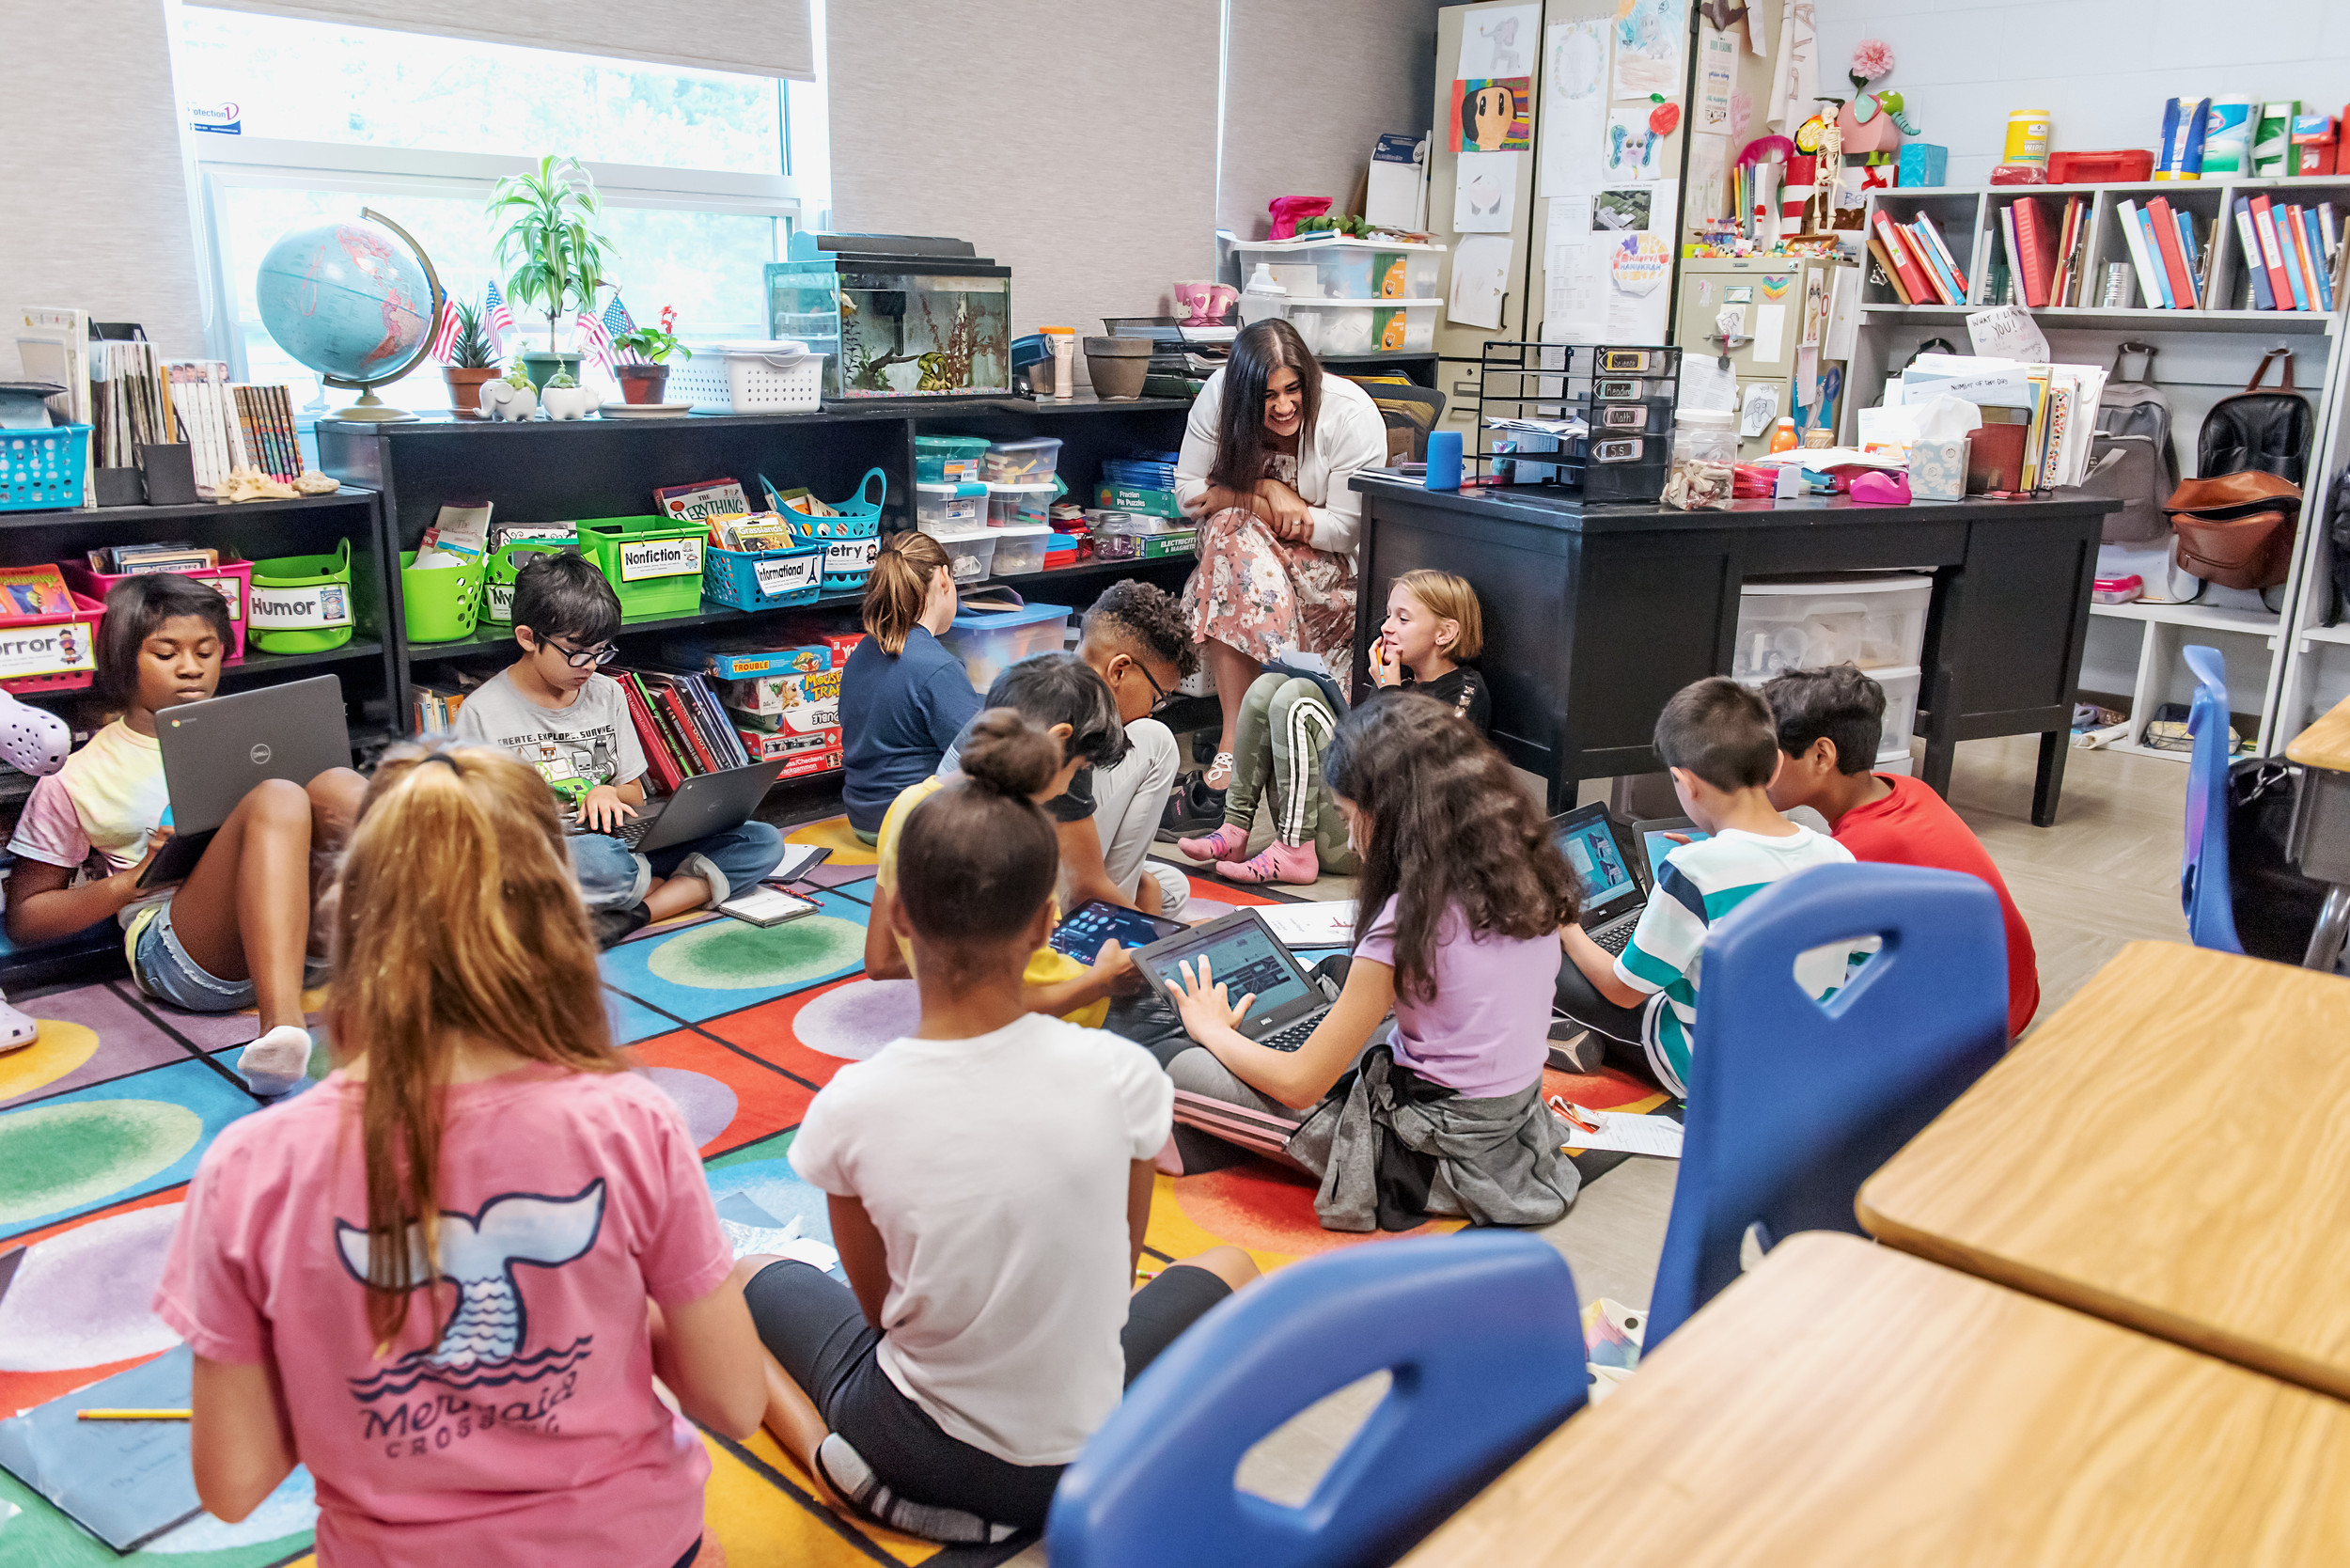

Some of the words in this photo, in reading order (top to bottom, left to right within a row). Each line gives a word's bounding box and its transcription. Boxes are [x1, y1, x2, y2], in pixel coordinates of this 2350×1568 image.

[188, 107, 227, 118] otection
[1613, 354, 1636, 368] Science
[1610, 411, 1631, 424] Math
[739, 525, 783, 534] Grasslands
[625, 548, 682, 566] Nonfiction
[826, 544, 863, 558] etry
[757, 562, 804, 582] Informational
[251, 597, 316, 616] Humor
[0, 637, 57, 656] rror
[733, 660, 770, 673] TROUBLE
[804, 669, 842, 690] MOUSE
[253, 750, 269, 759] DELL
